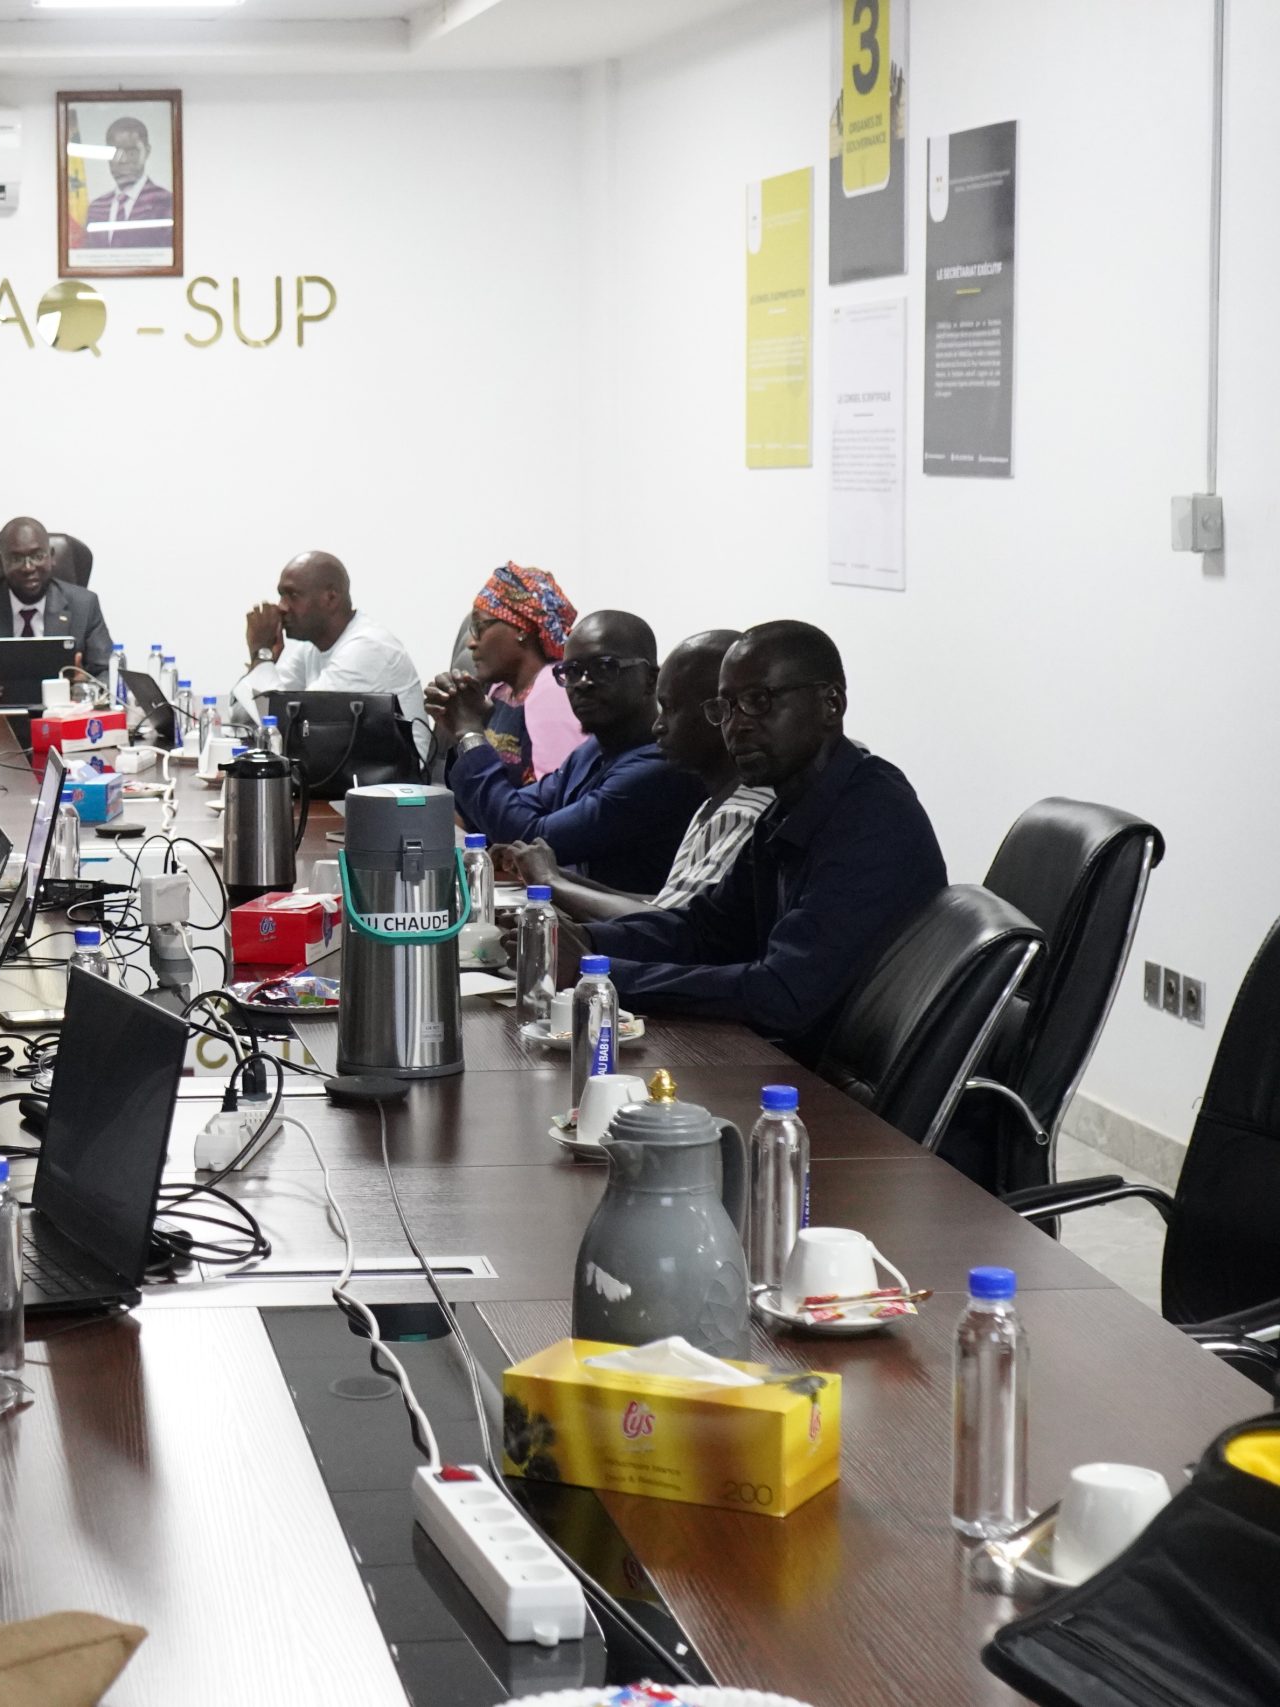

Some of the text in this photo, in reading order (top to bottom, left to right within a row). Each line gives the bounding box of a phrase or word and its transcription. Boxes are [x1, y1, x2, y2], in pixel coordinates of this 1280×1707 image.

[852, 0, 880, 95] 3
[184, 275, 338, 349] SUP
[723, 1480, 774, 1506] 200
